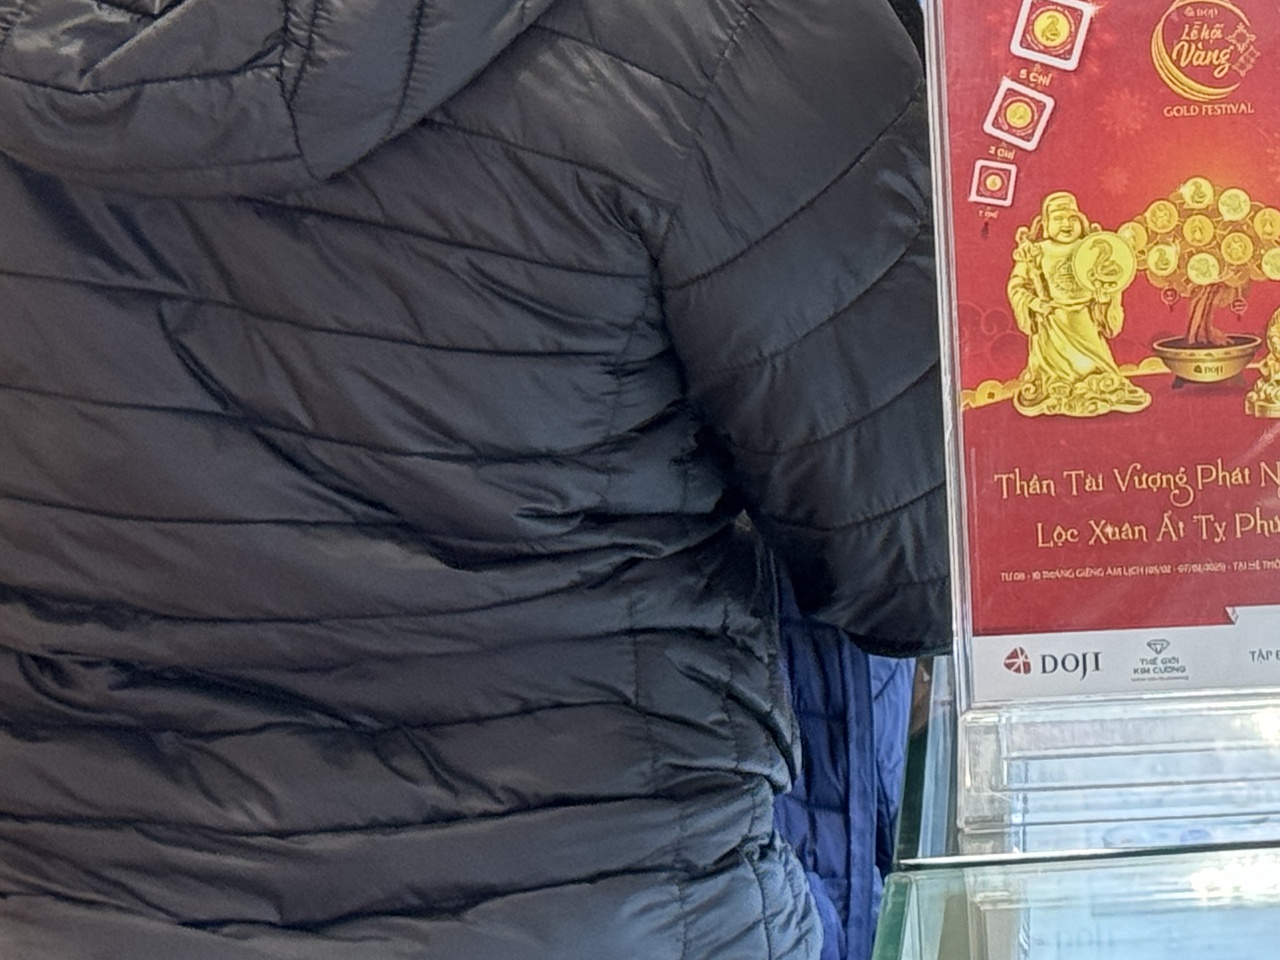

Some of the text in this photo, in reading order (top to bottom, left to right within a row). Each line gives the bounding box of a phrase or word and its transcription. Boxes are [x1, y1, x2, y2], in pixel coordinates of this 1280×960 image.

[1171, 40, 1235, 79] Vàng
[1163, 102, 1256, 118] GOLD FESTIVAL
[1040, 651, 1103, 681] DOJI
